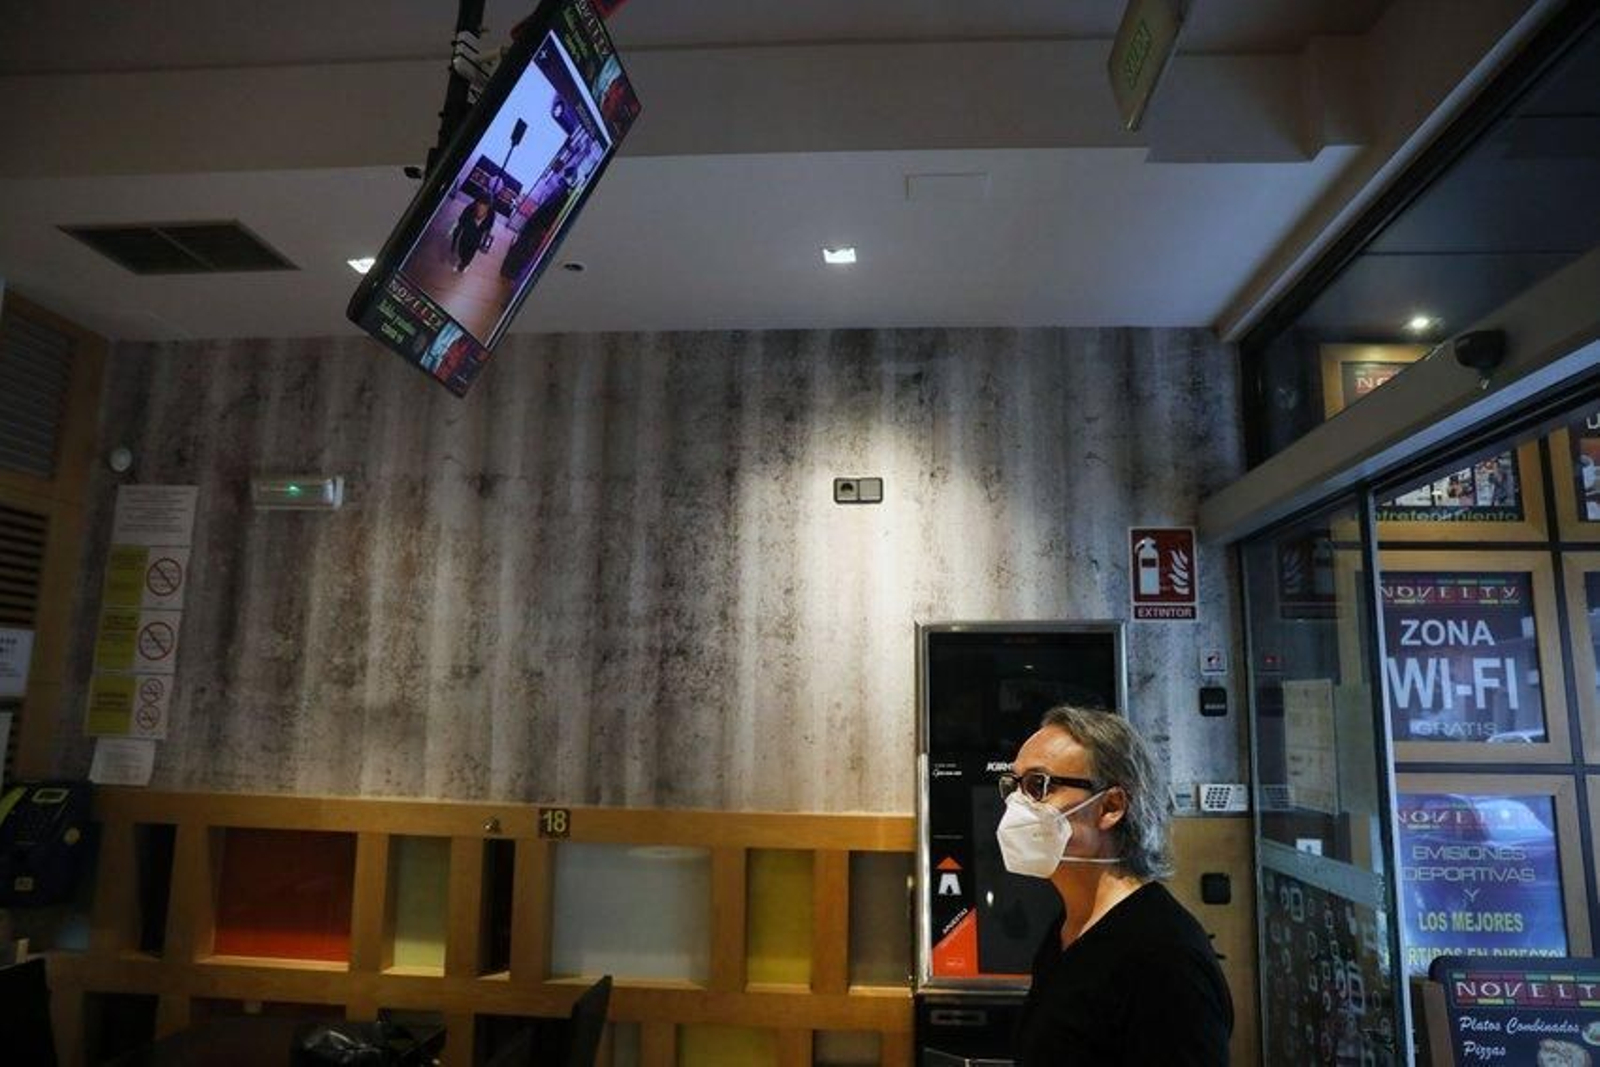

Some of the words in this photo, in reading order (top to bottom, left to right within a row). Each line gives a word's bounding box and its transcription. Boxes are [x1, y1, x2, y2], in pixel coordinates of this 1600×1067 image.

[1379, 586, 1516, 599] NOVELTY
[1137, 606, 1192, 618] EXTINTOR
[1401, 619, 1496, 646] ZONA
[1387, 657, 1519, 710] WI-FI
[1414, 720, 1498, 736] GRATIS
[543, 809, 567, 832] 18
[1412, 846, 1527, 861] EMISIONES
[1402, 866, 1536, 883] DEPORTIVAS
[1464, 888, 1480, 902] Y
[1418, 911, 1448, 931] LOS
[1452, 911, 1524, 932] MEJORES
[1459, 1016, 1500, 1032] Platos
[1506, 1017, 1579, 1034] Combinados
[1463, 1041, 1507, 1060] Pizzas
